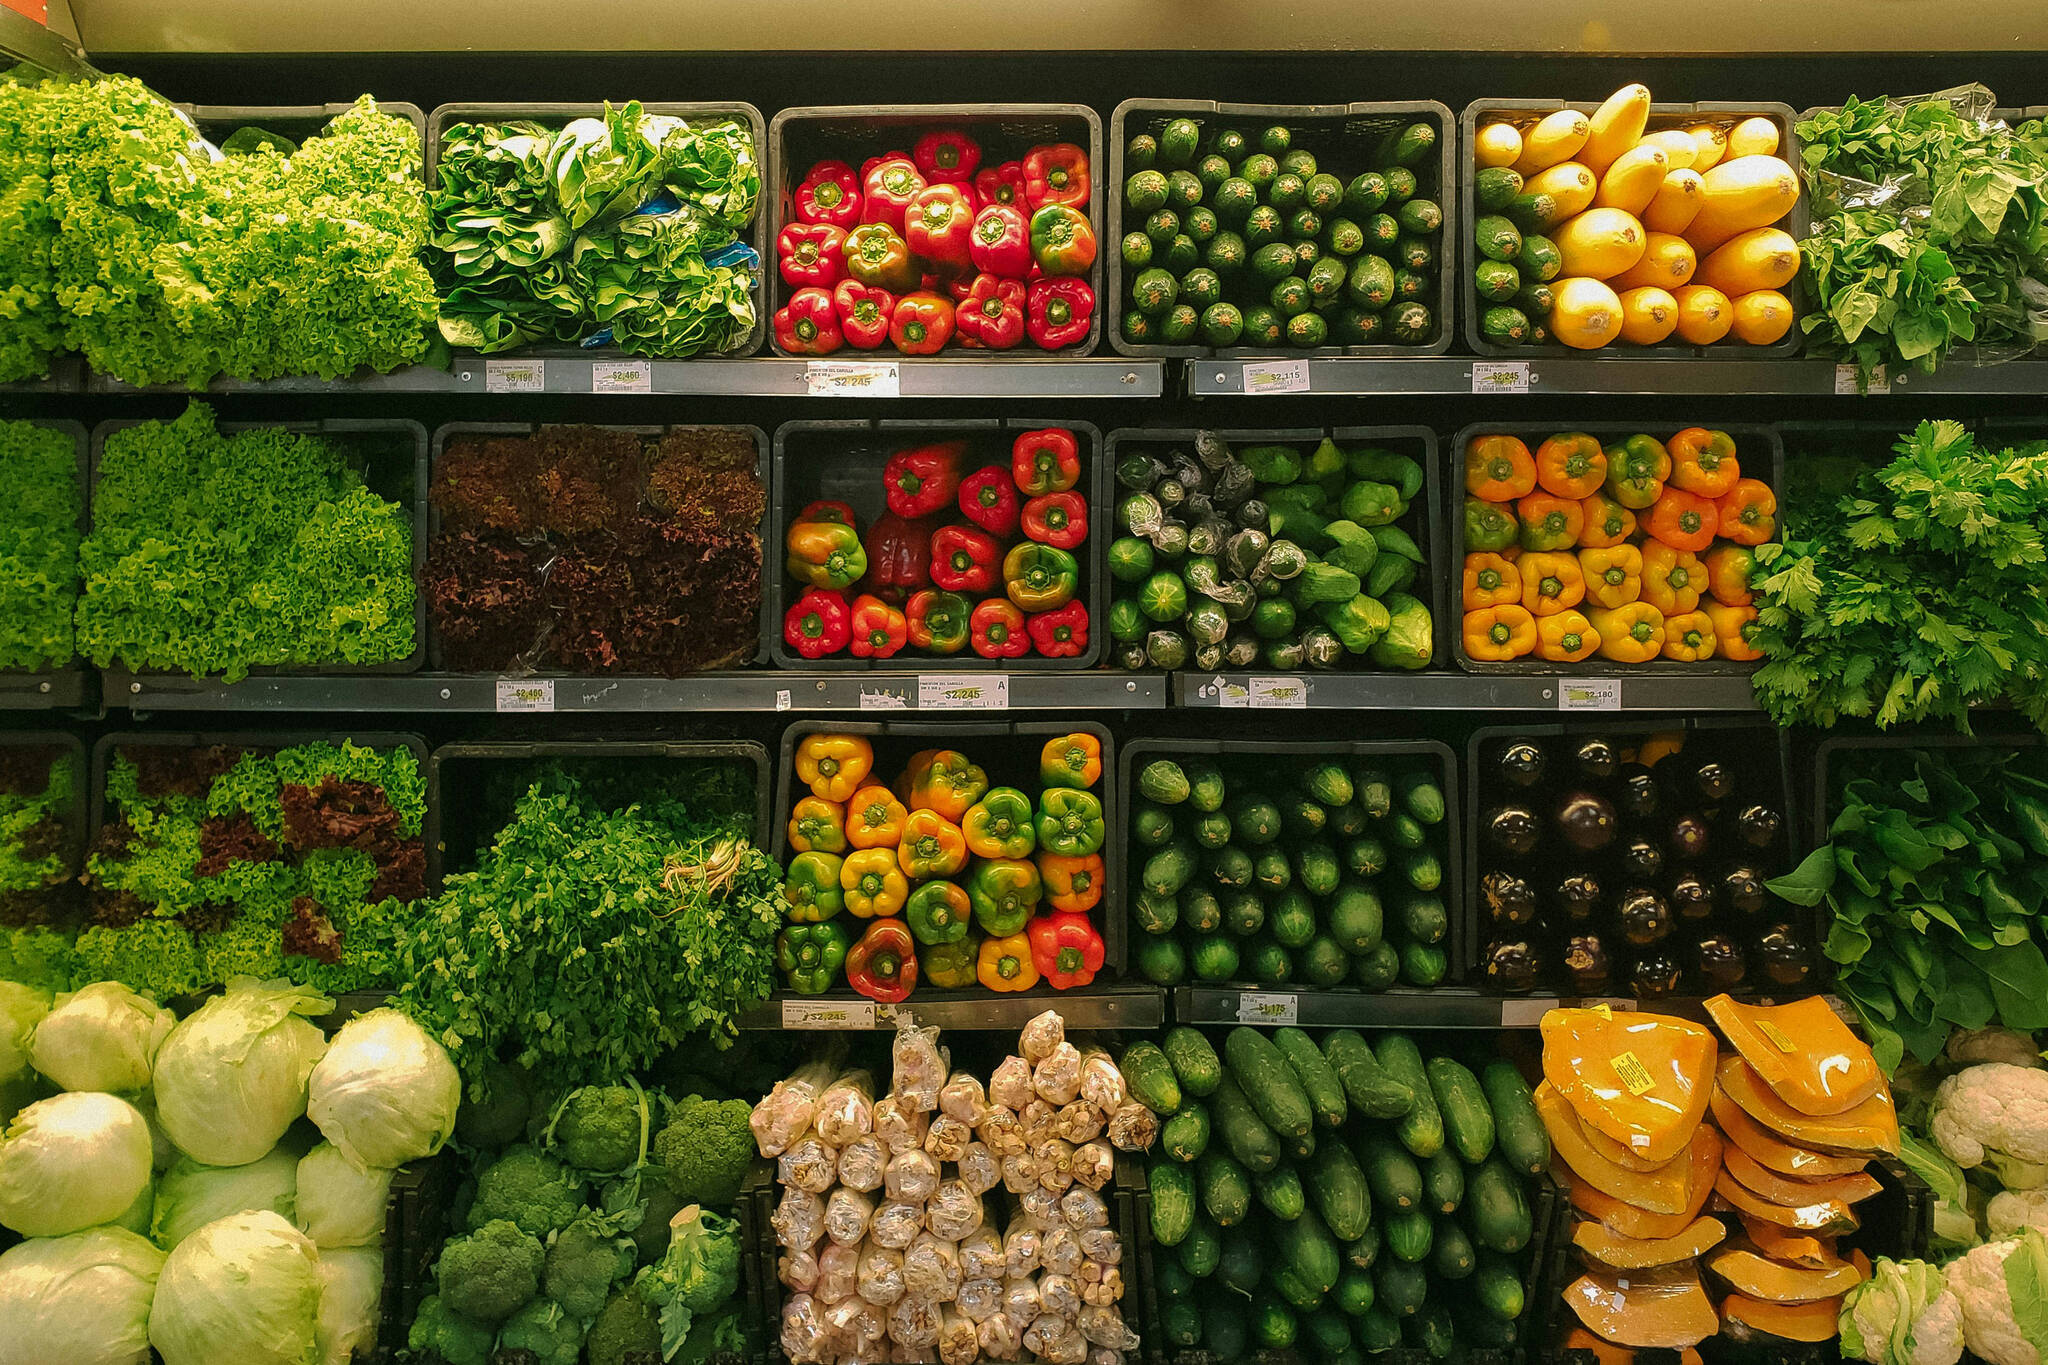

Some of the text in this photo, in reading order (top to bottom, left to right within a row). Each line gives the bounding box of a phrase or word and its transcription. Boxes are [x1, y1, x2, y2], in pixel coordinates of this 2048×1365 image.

[538, 365, 543, 374] C
[889, 368, 897, 378] A
[612, 371, 640, 381] $2,460
[1492, 371, 1519, 381] $2,245
[834, 377, 872, 387] $2245
[998, 681, 1005, 690] A
[945, 690, 980, 700] $2,245
[1272, 687, 1299, 698] $3,235
[1290, 996, 1295, 1005] A
[864, 1006, 872, 1014] A
[1258, 1003, 1286, 1013] $1,175
